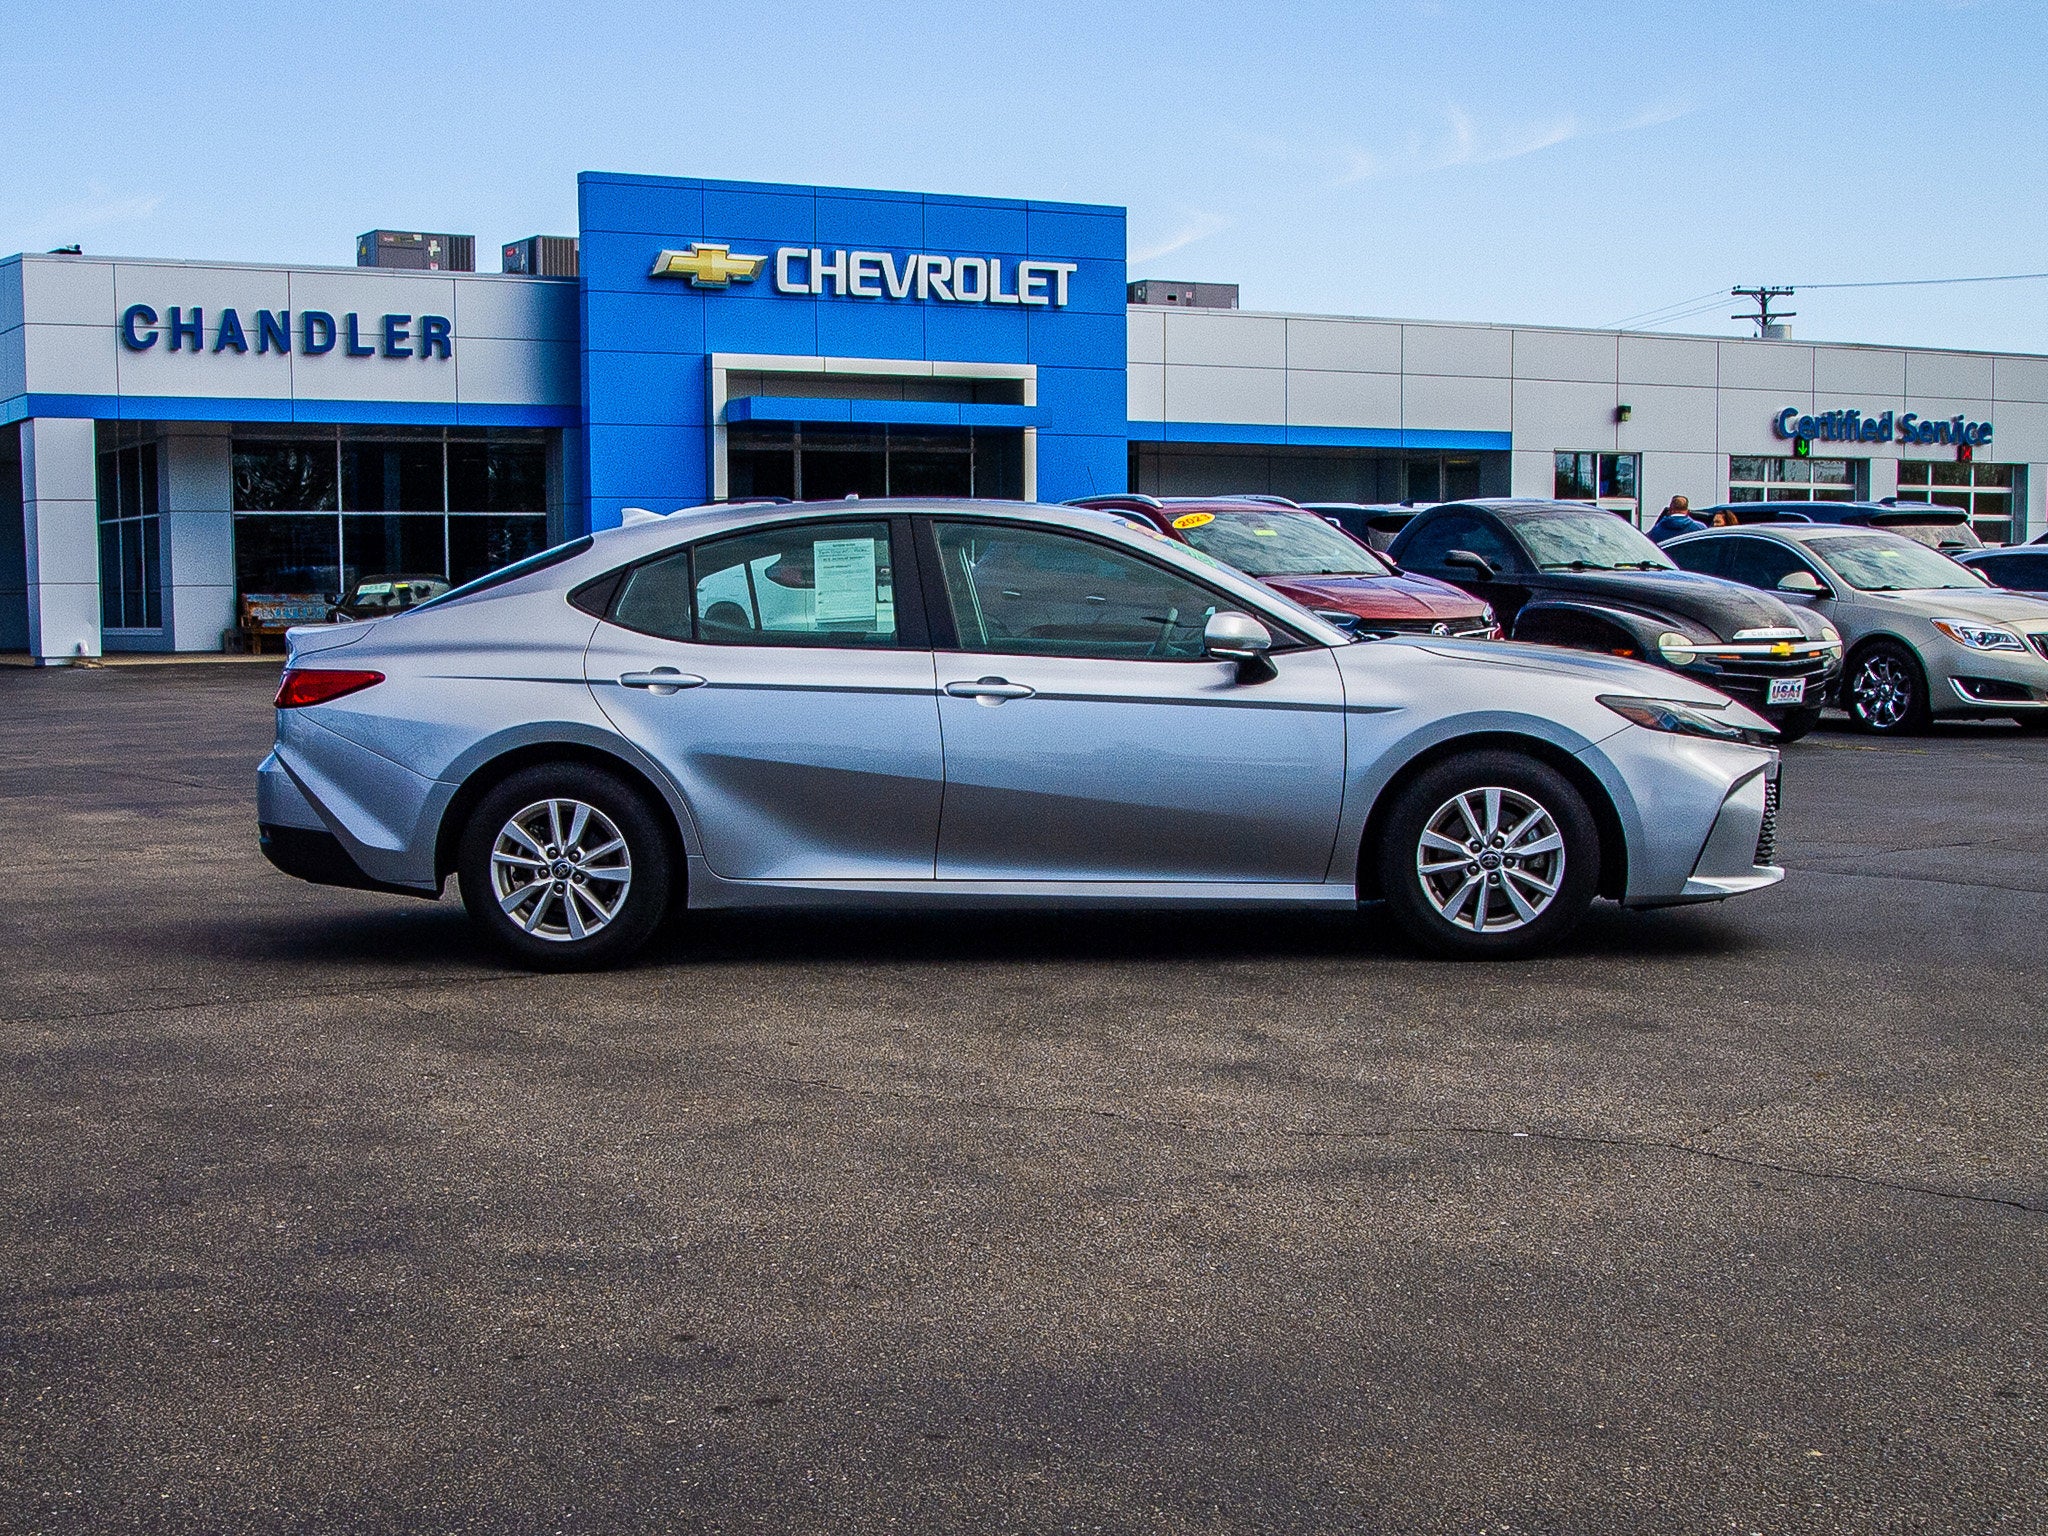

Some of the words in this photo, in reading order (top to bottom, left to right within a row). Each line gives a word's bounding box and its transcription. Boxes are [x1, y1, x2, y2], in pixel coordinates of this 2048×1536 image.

[776, 247, 1078, 306] CHEVROLET
[122, 304, 453, 358] CHANDLER
[1776, 407, 1894, 442] Certified
[1900, 412, 1993, 445] Service
